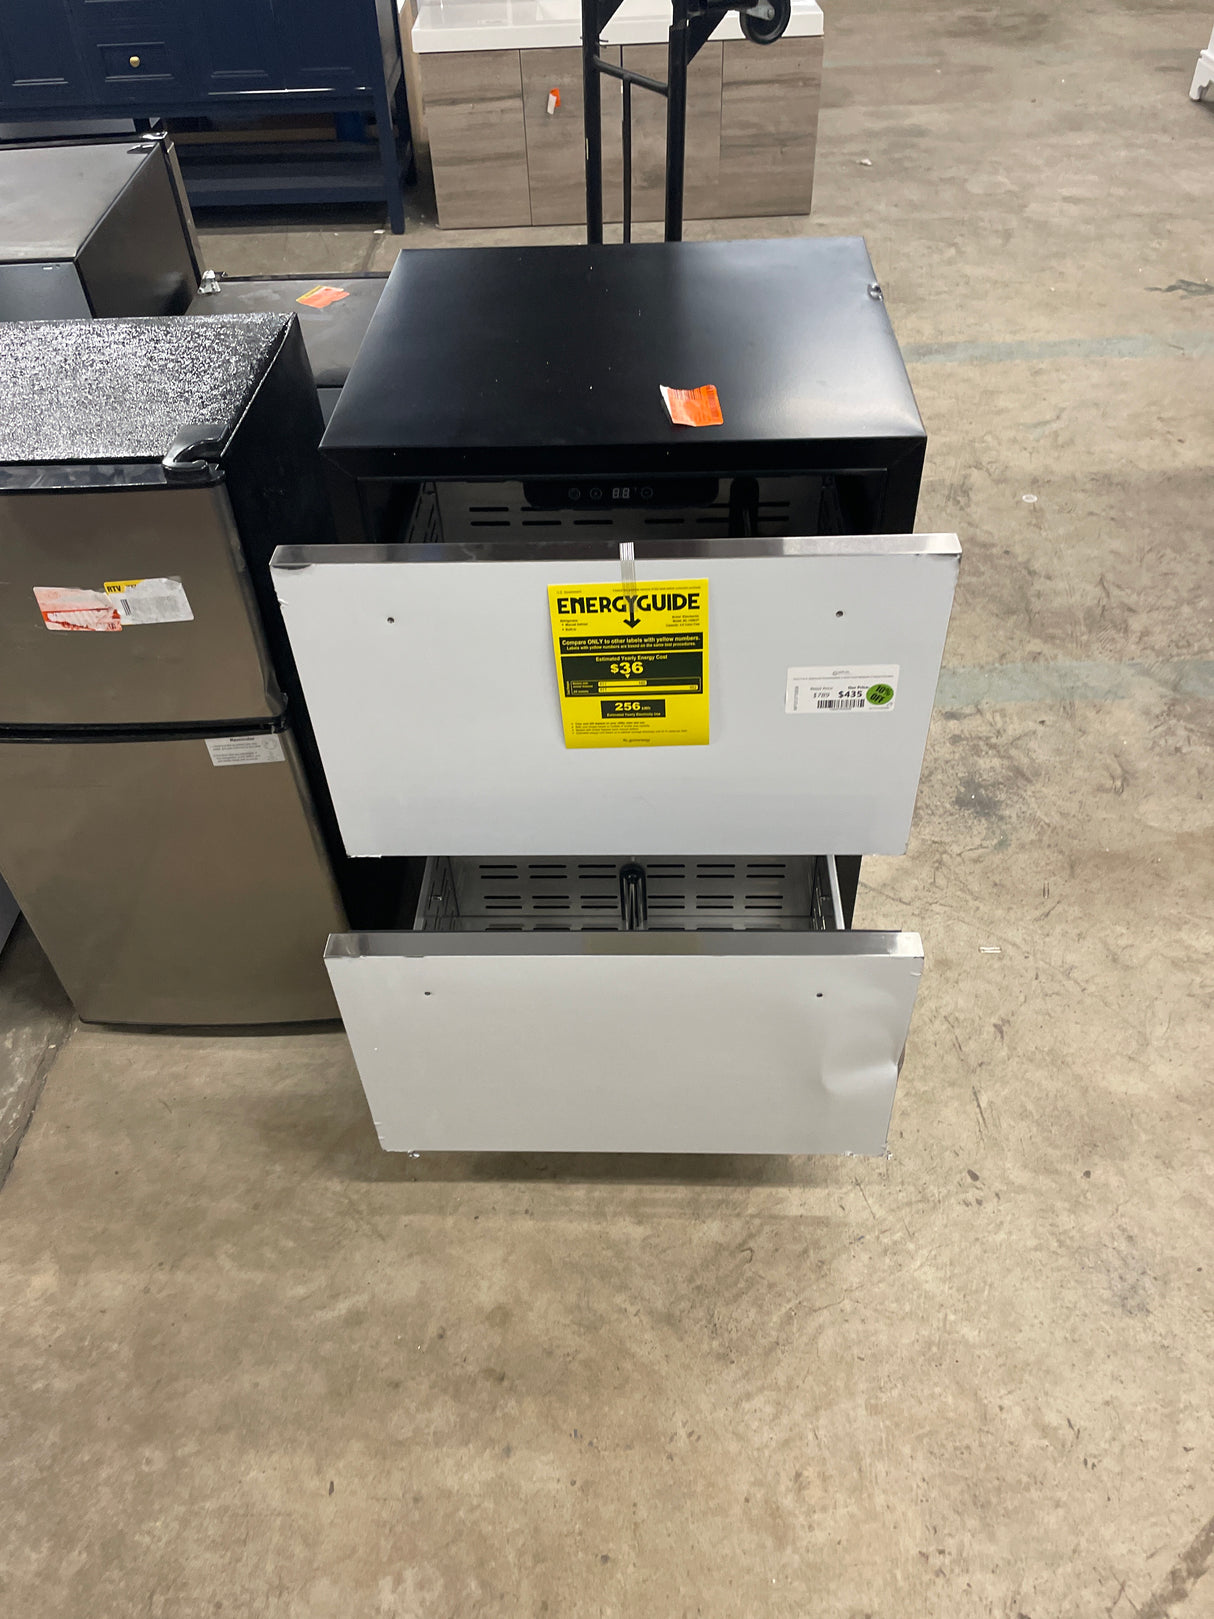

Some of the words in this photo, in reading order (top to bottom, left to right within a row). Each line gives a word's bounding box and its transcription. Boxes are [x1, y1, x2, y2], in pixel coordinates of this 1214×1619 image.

[107, 585, 122, 593] RTV
[557, 593, 700, 614] ENERGYGUIDE
[610, 662, 644, 674] $36
[838, 690, 863, 699] $435
[875, 685, 891, 697] 10%
[869, 692, 886, 703] OFF
[615, 702, 640, 711] 256
